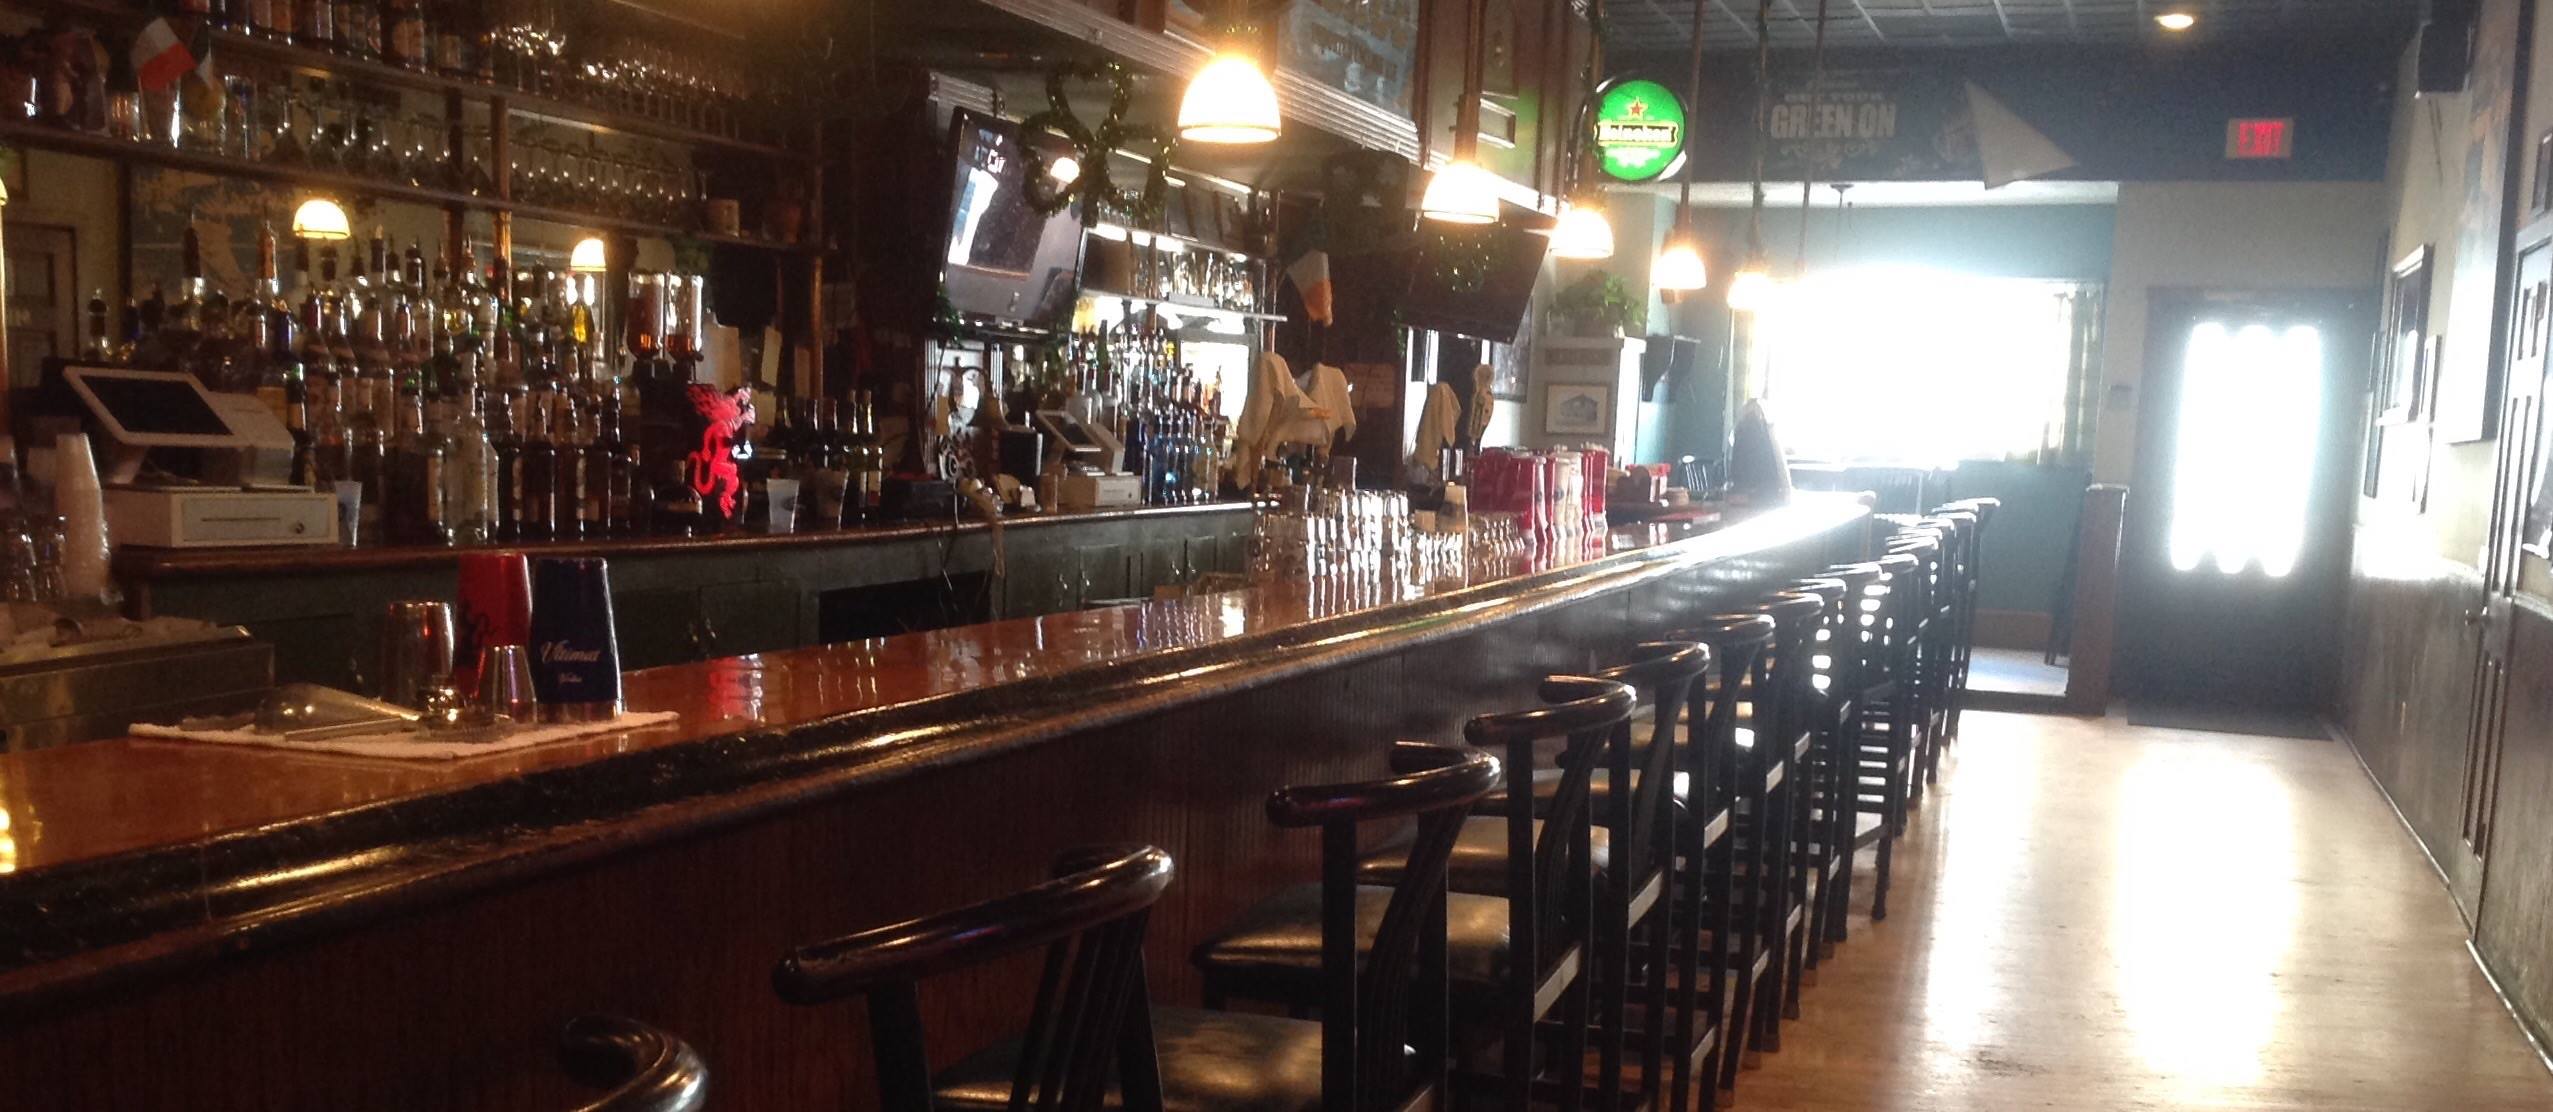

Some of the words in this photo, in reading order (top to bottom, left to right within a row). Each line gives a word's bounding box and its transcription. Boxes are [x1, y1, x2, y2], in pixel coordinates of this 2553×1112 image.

[1771, 102, 1852, 138] GREEN
[1858, 102, 1896, 138] ON
[2237, 120, 2285, 156] EXIT
